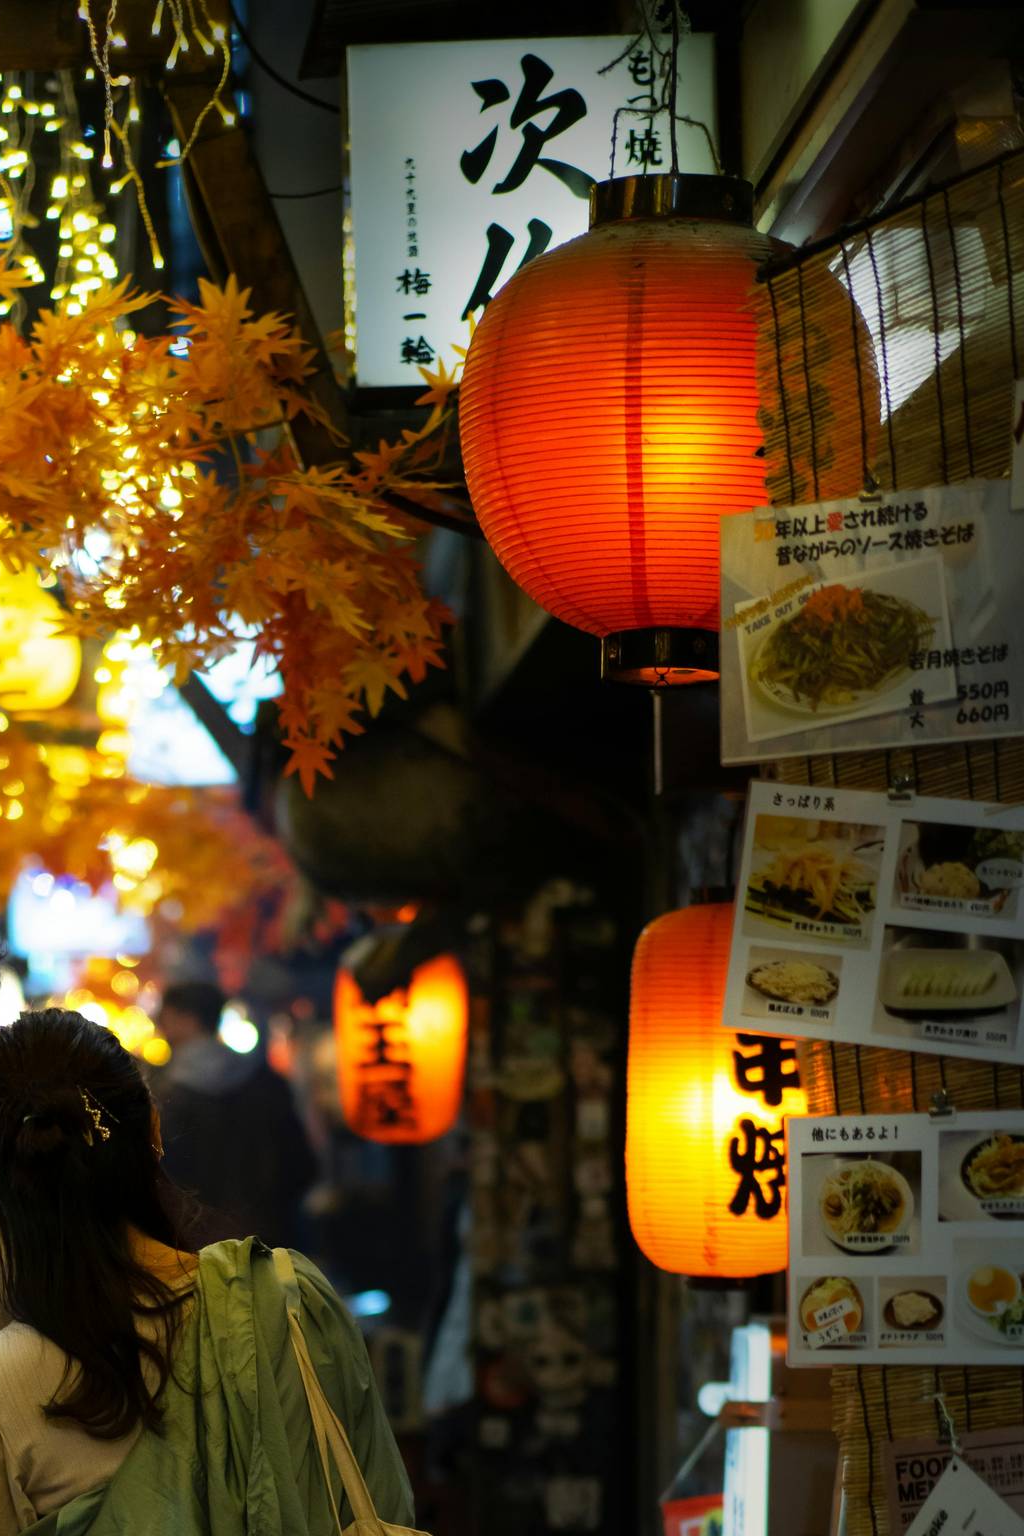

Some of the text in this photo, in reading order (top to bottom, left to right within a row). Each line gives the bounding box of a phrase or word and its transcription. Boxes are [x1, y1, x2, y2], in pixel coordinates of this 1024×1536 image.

[396, 267, 434, 366] 梅一輪
[776, 523, 975, 566] 昔ながらのソース焼きそば
[957, 680, 1010, 702] 550円
[909, 703, 1010, 729] 大 660円
